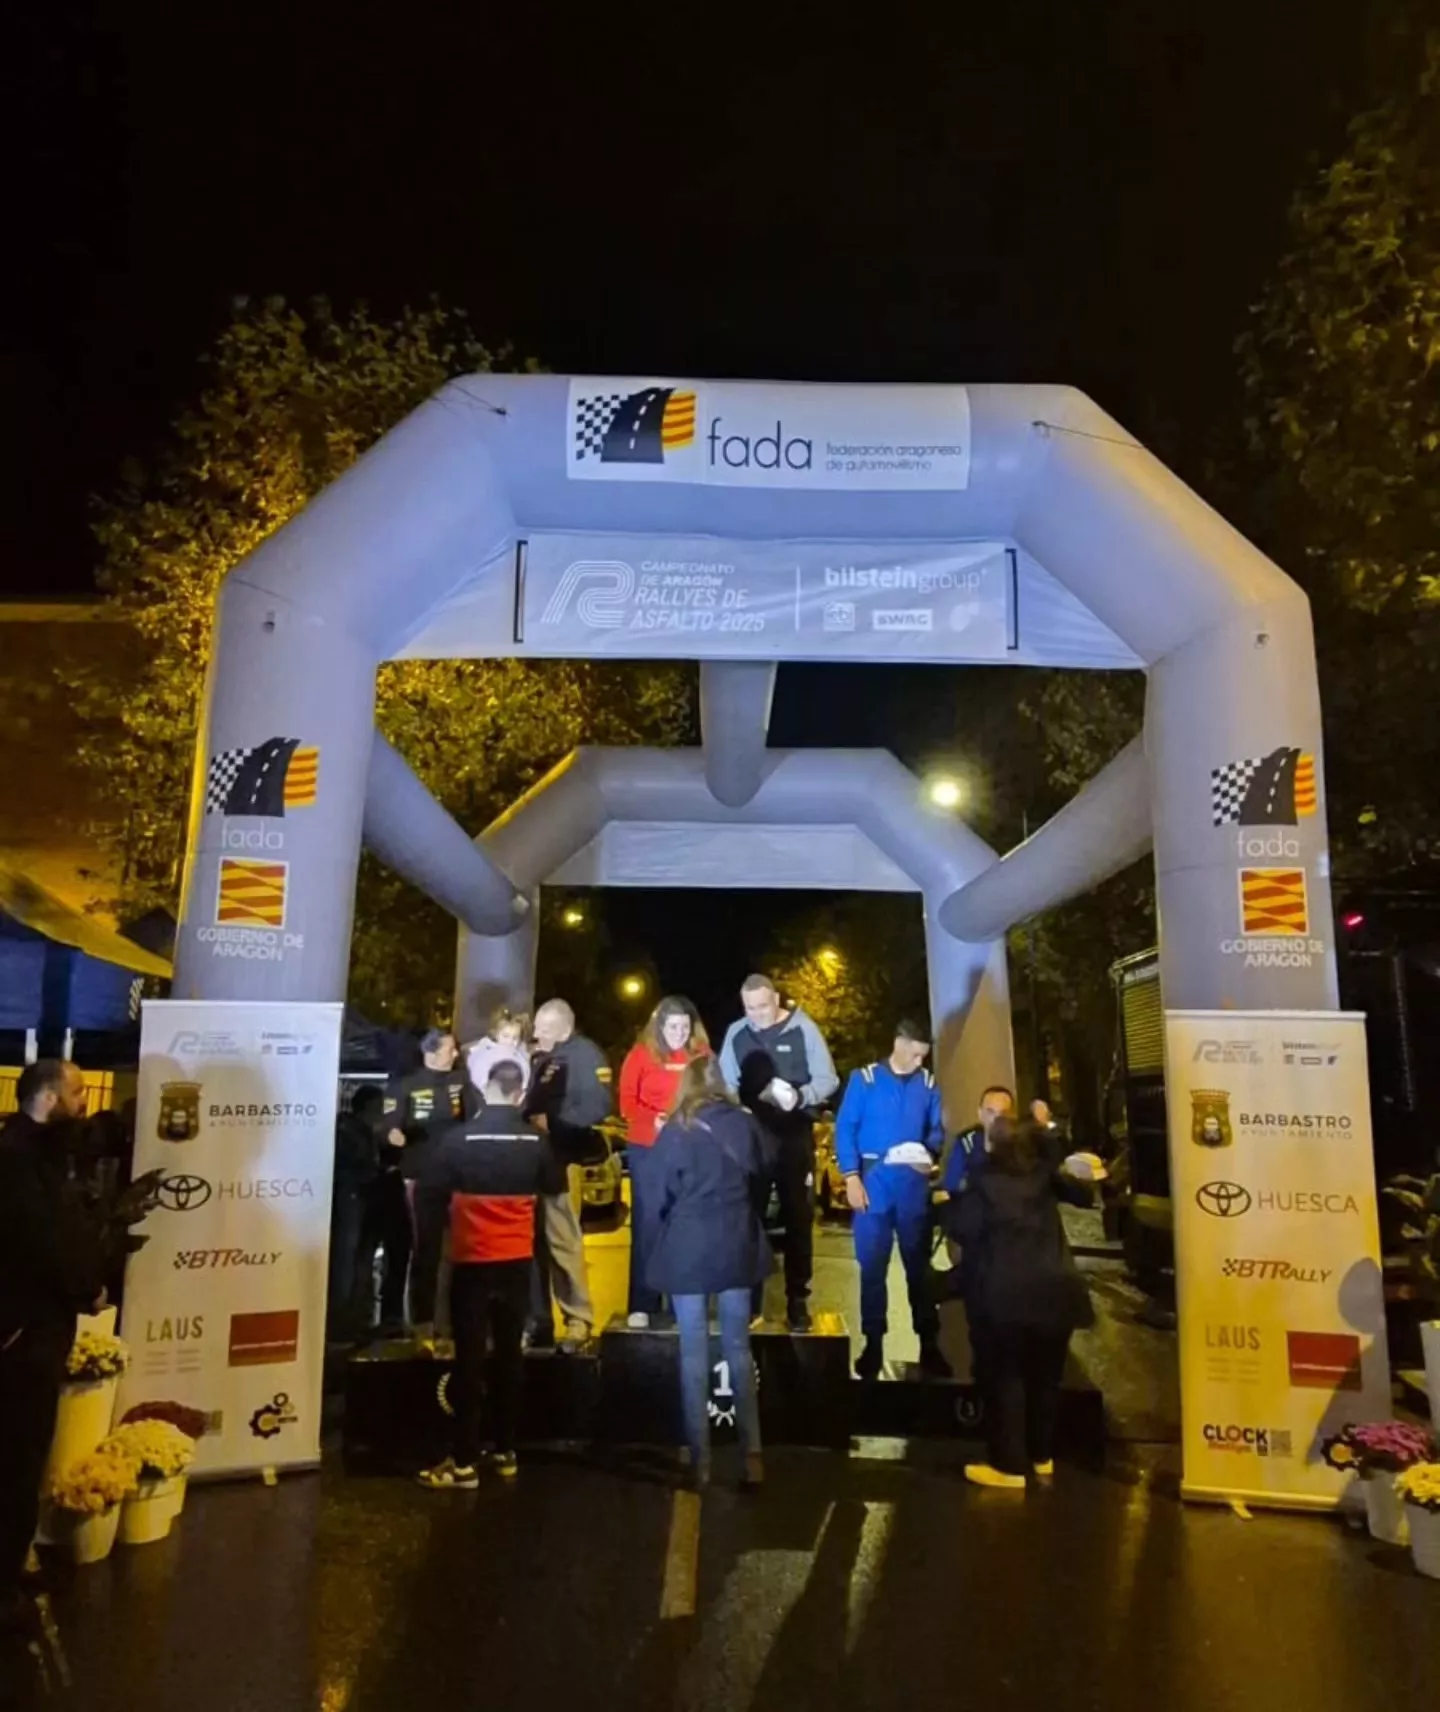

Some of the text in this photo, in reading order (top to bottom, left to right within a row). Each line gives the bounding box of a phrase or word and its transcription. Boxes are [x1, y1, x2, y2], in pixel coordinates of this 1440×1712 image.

[706, 415, 813, 471] fada
[826, 460, 843, 471] de
[641, 561, 736, 575] CAMPEONATO
[641, 574, 660, 586] DE
[634, 588, 751, 608] RALLYES DE
[629, 609, 767, 632] ASFALTO 2025
[220, 820, 284, 850] fada
[1236, 830, 1300, 858] fada
[197, 928, 305, 948] GOBIERNO DE
[1220, 938, 1325, 954] GOBIERNO DE
[208, 1103, 318, 1117] BARBASTRO
[1239, 1112, 1352, 1130] BARBASTRO
[218, 1178, 314, 1200] HUESCA
[1257, 1191, 1360, 1215] HUESCA
[146, 1315, 204, 1343] LAUS
[1205, 1323, 1262, 1351] LAUS
[713, 1359, 734, 1397] 1
[1202, 1423, 1268, 1446] CLOCK
